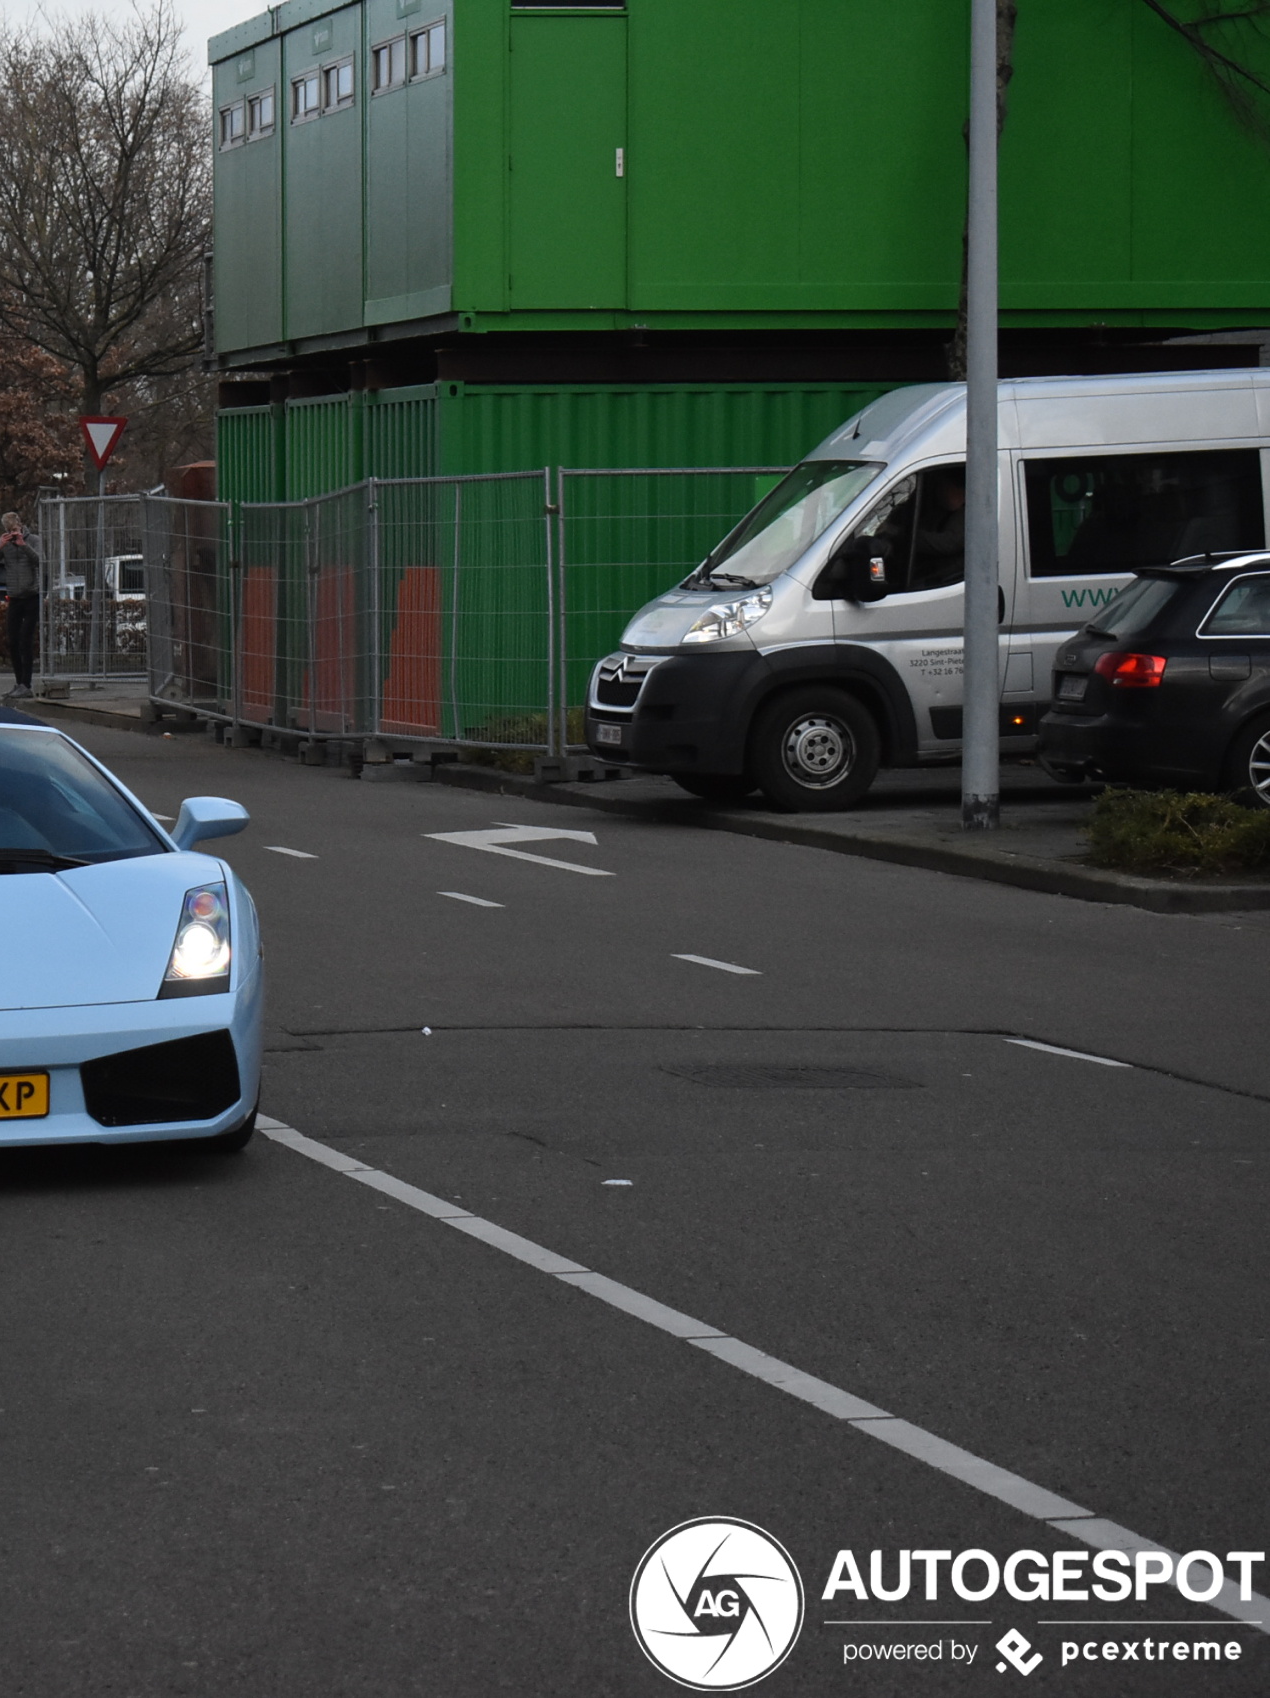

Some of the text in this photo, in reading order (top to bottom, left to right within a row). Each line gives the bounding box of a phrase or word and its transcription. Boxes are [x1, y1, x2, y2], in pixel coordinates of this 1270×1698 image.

[1061, 587, 1118, 608] ww
[910, 658, 928, 667] 3220
[928, 668, 942, 676] +32
[944, 667, 953, 676] 16
